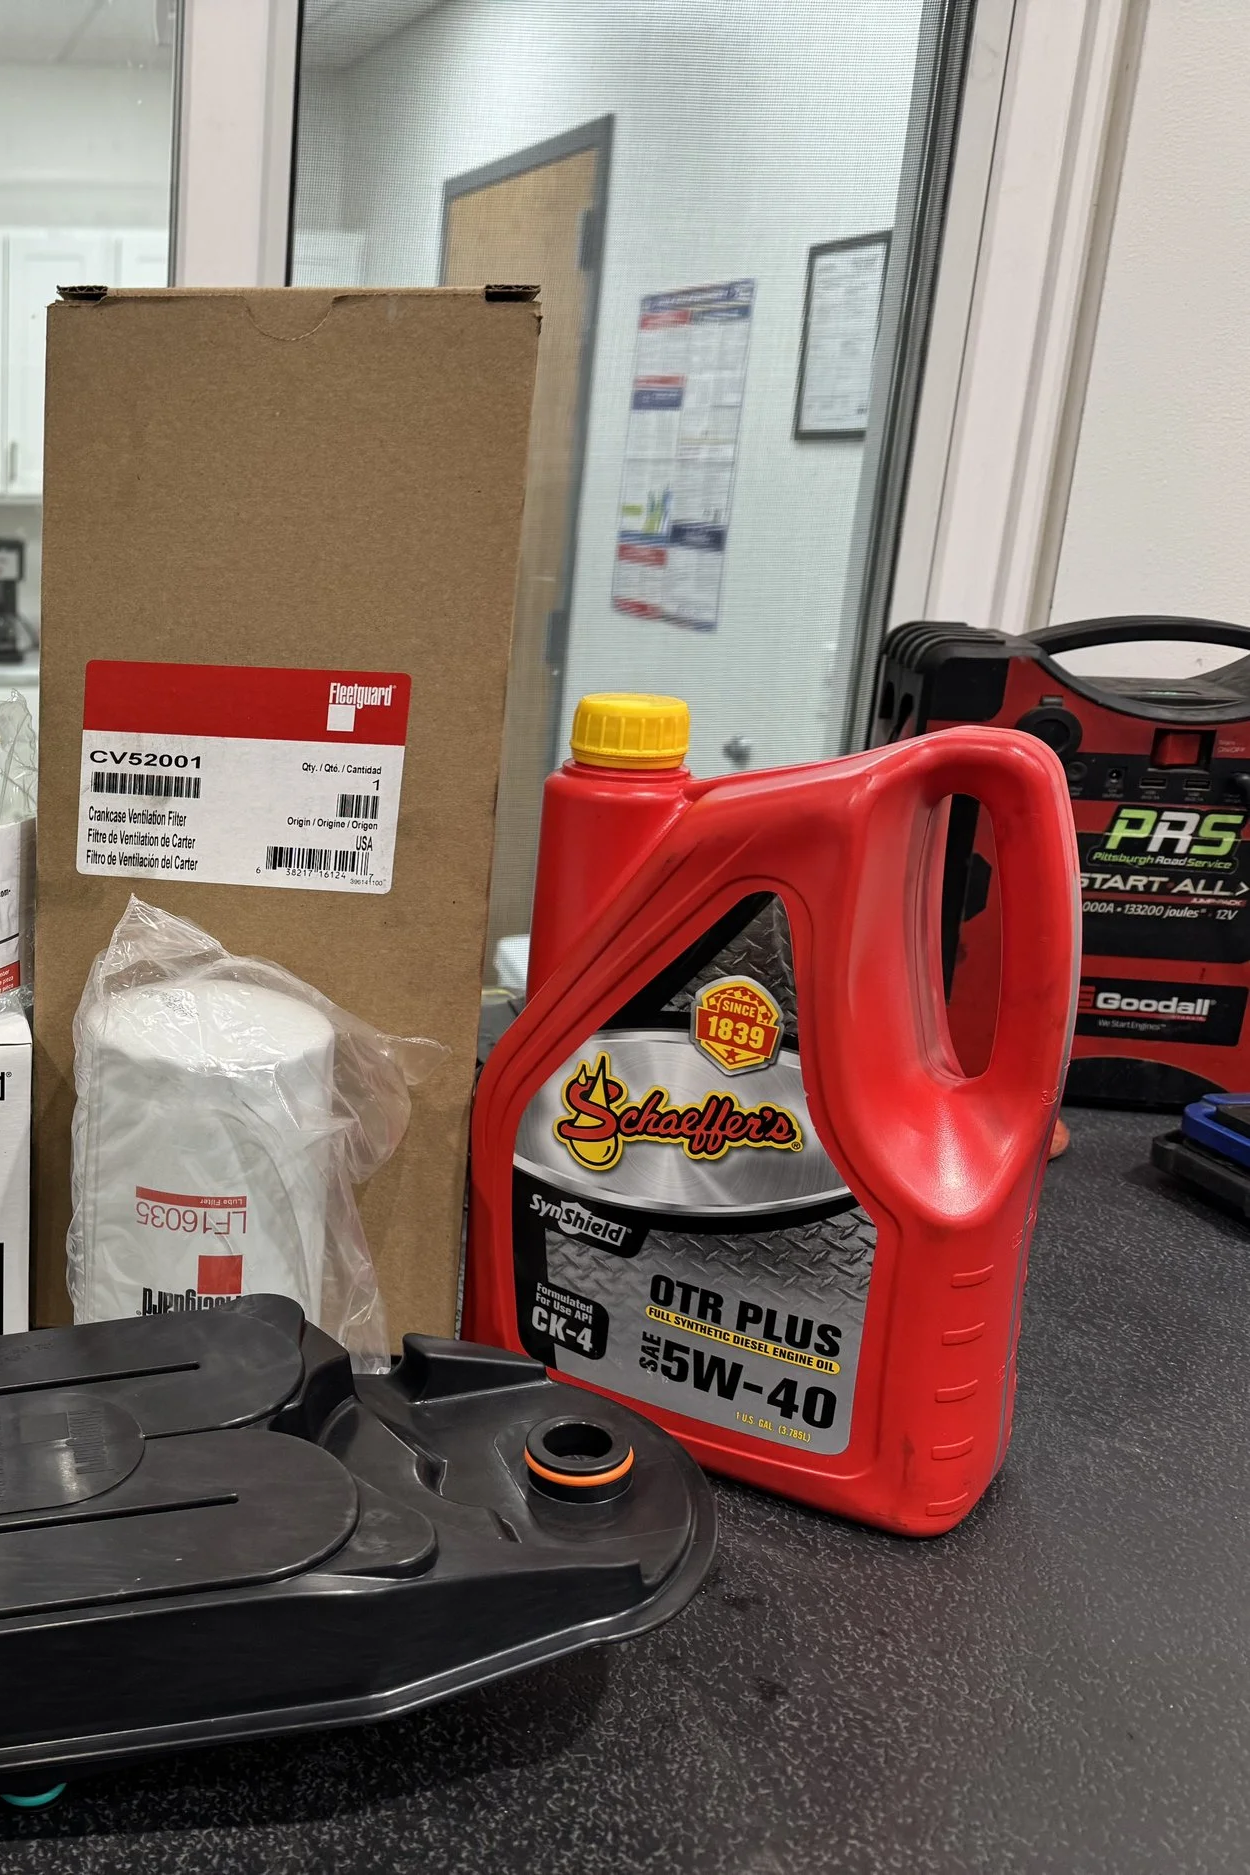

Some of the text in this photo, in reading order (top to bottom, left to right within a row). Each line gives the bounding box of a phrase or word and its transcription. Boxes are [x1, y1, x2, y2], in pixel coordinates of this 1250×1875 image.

[328, 682, 393, 709] Fleetguard
[89, 750, 202, 770] CV52001
[302, 762, 318, 773] Qty.
[346, 764, 382, 775] Cantidad
[372, 779, 380, 791] 1
[88, 806, 187, 828] Crankcase Ventilation Filter
[287, 816, 311, 828] Origin
[317, 818, 345, 829] Origine
[351, 820, 378, 831] Origen
[87, 828, 196, 850] Filtre de Ventilation de Carter
[355, 835, 373, 851] USA
[1105, 808, 1245, 856] PRS
[86, 849, 198, 872] Filtro de Ventilación del Carter
[1092, 851, 1233, 870] Pittsburgh Road Service
[255, 866, 261, 874] 6
[286, 868, 313, 877] 38217
[319, 871, 346, 879] 16124
[1171, 877, 1235, 897] ALL
[1123, 903, 1164, 917] 133200
[1216, 909, 1239, 920] 12V
[721, 999, 757, 1018] SINCE
[1096, 992, 1211, 1016] Goodall
[707, 1015, 765, 1050] 1839
[558, 1070, 800, 1156] Schaeffer's
[199, 1197, 221, 1207] Filter
[136, 1201, 248, 1235] LF16035
[529, 1193, 628, 1248] SynShield
[535, 1282, 594, 1315] Formulated
[535, 1292, 593, 1325] For Use API
[650, 1273, 842, 1358] OTR PLUS
[531, 1304, 594, 1352] CK-4
[648, 1306, 836, 1372] FULL SYNTHETIC DIESEL ENGINE OIL
[639, 1330, 662, 1374] SAE
[661, 1337, 838, 1430] 5W-40
